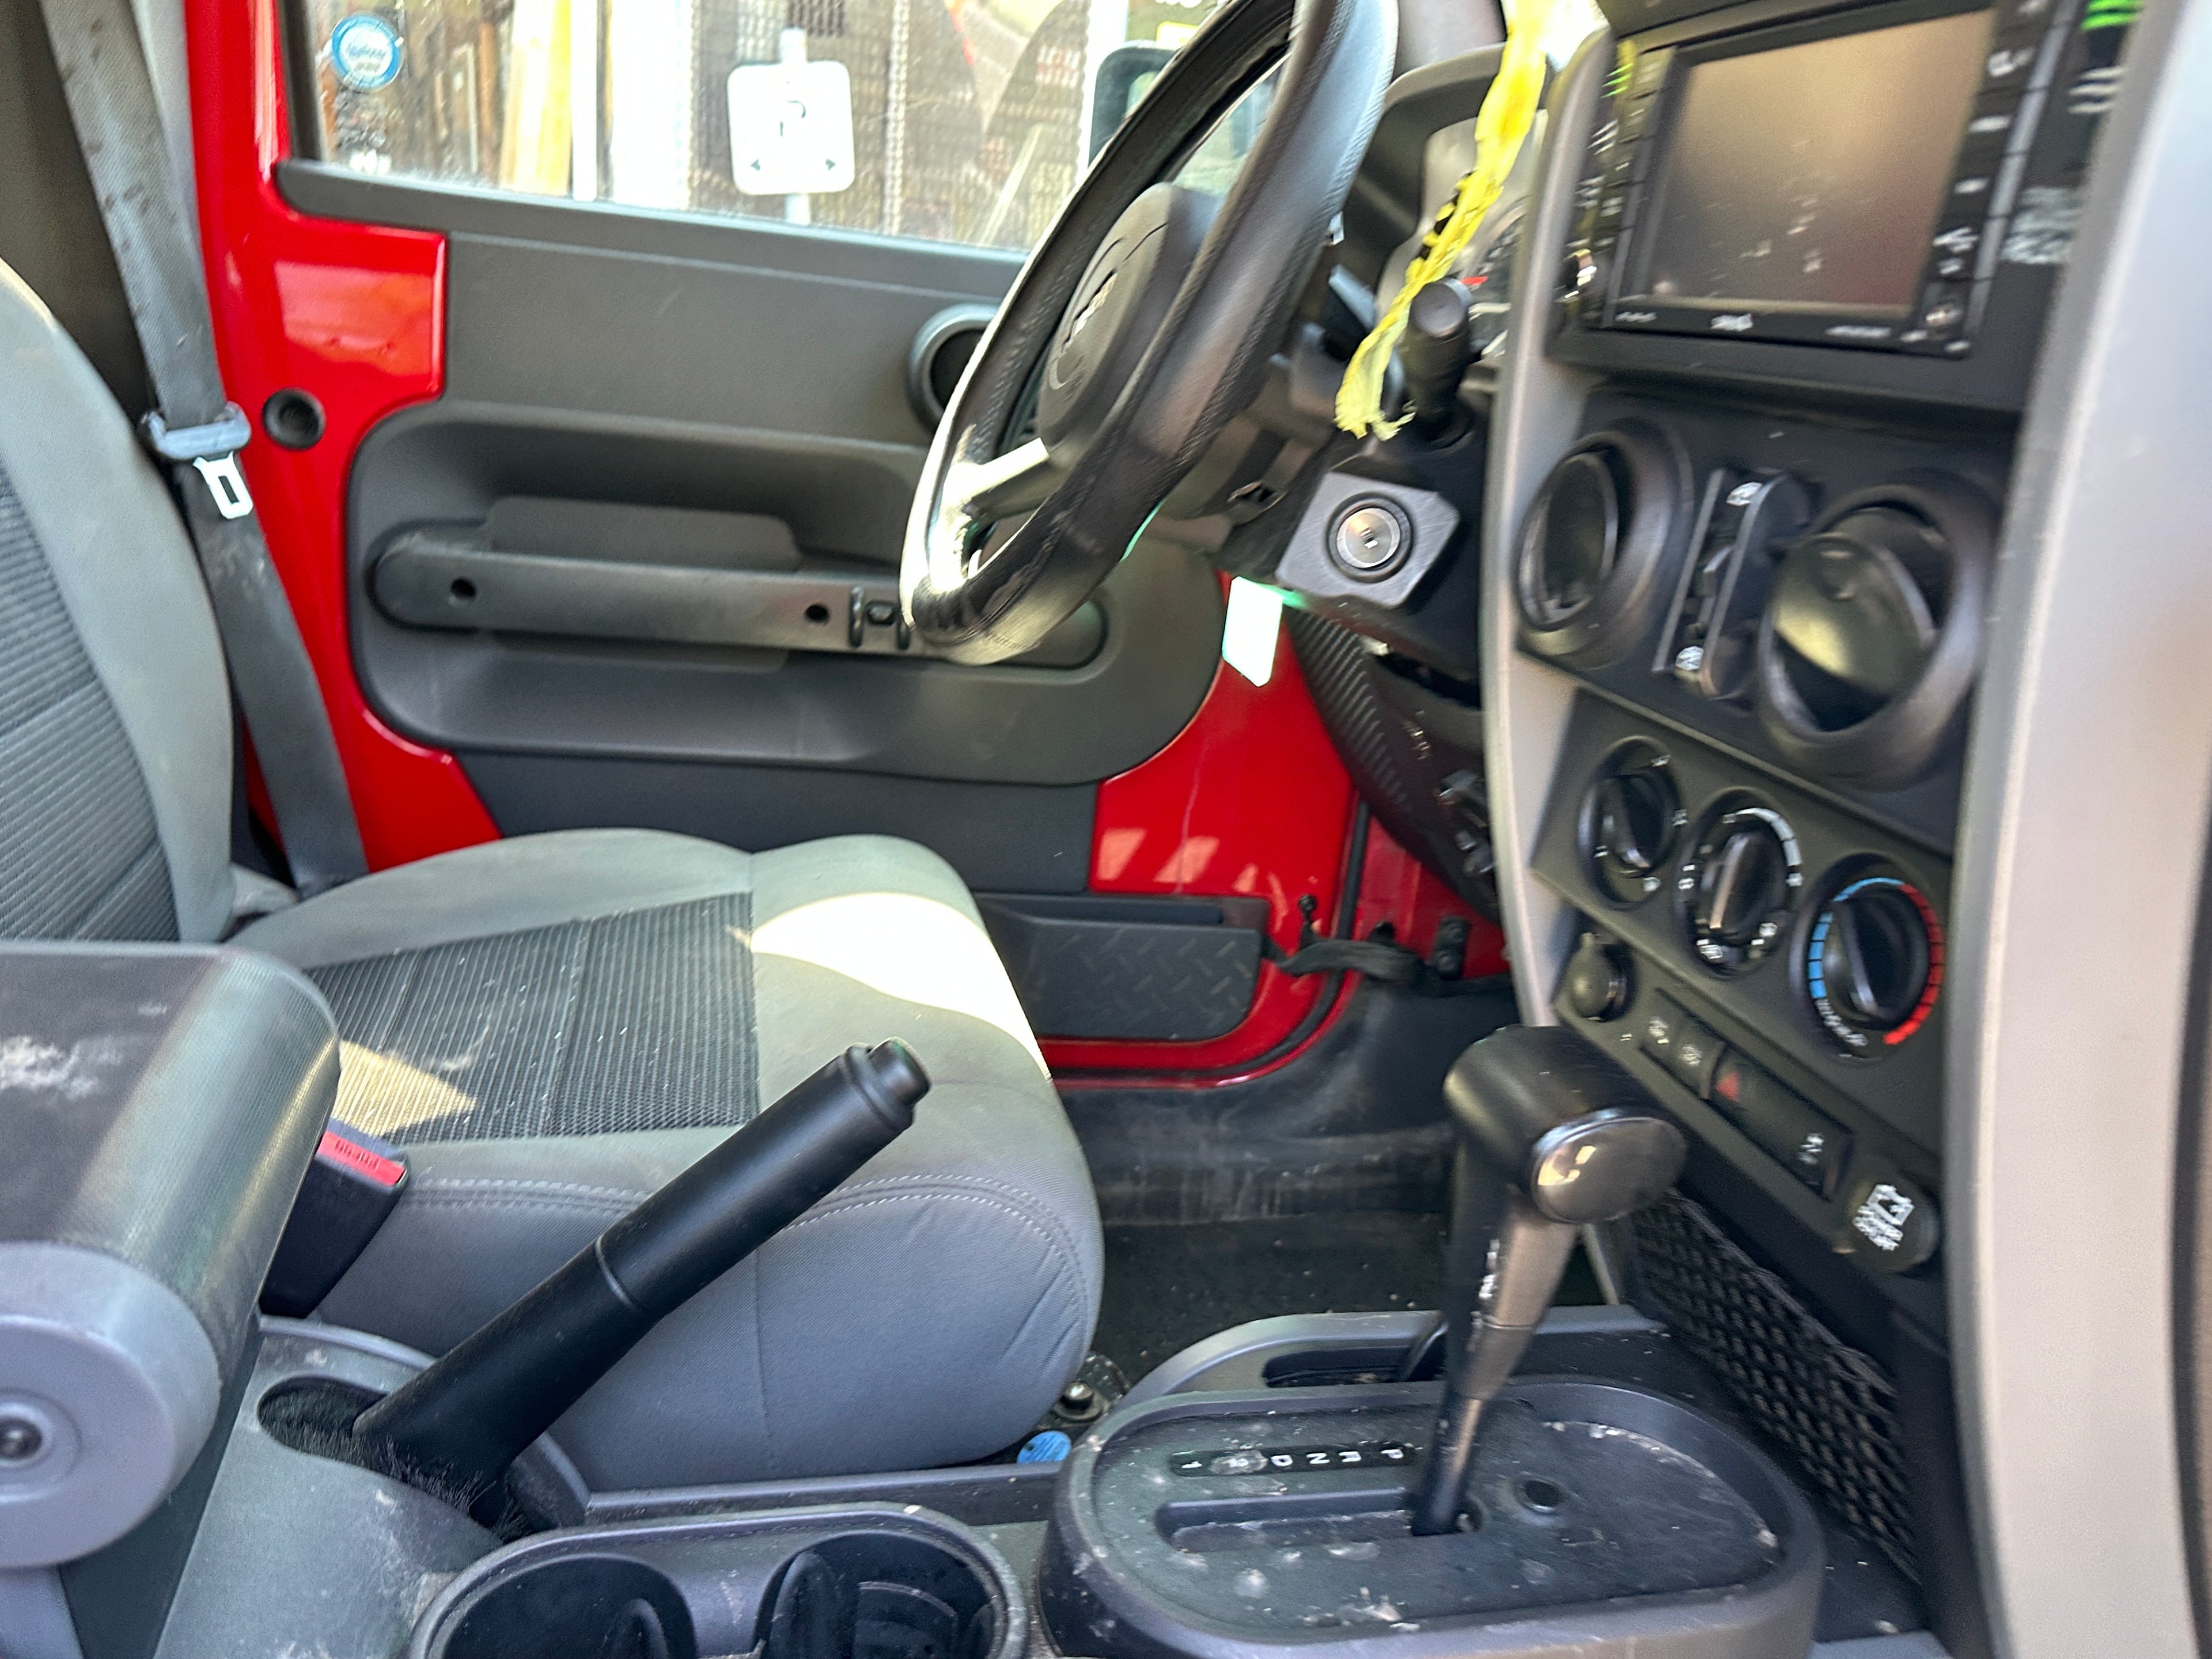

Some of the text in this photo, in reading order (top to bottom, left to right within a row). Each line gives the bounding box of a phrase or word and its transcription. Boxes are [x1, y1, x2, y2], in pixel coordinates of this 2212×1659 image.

[1270, 1454, 1293, 1467] D
[1306, 1452, 1330, 1465] N
[1381, 1448, 1404, 1460] P
